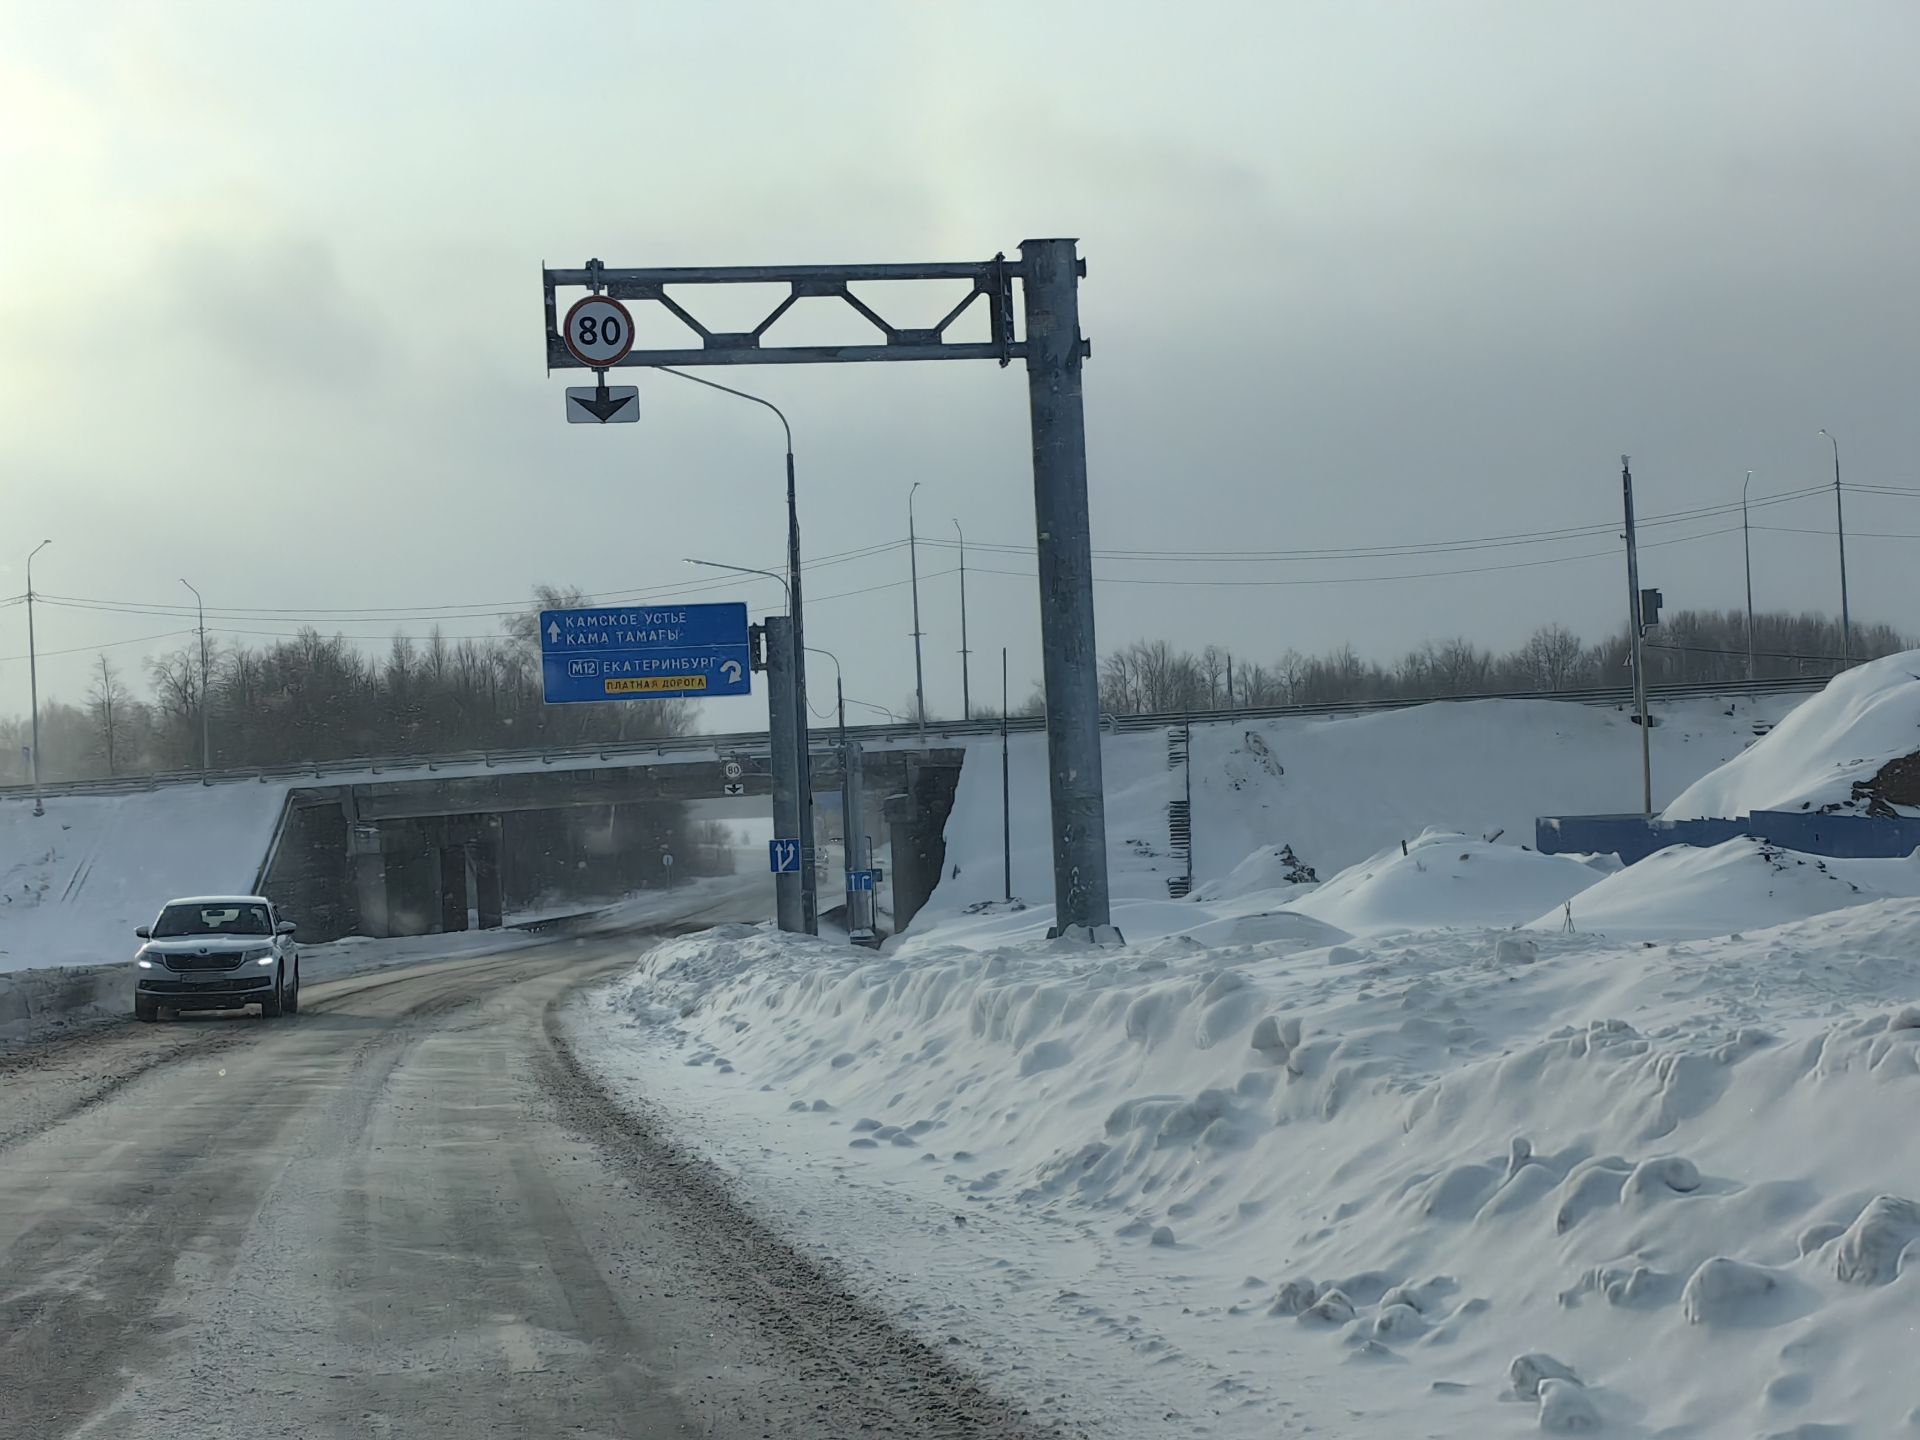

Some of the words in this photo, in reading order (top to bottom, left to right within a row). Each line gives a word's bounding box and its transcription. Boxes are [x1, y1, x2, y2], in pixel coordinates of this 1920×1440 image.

[579, 316, 621, 346] 80
[565, 615, 637, 628] КАМСКОЕ
[644, 612, 687, 625] УСТЬЕ
[566, 631, 609, 645] КАМА
[603, 656, 717, 673] ЕКАТЕРИНБУРГ
[606, 680, 658, 690] ПЛАТНАЯ
[662, 677, 704, 688] ДОРОГА
[728, 766, 740, 775] 80
